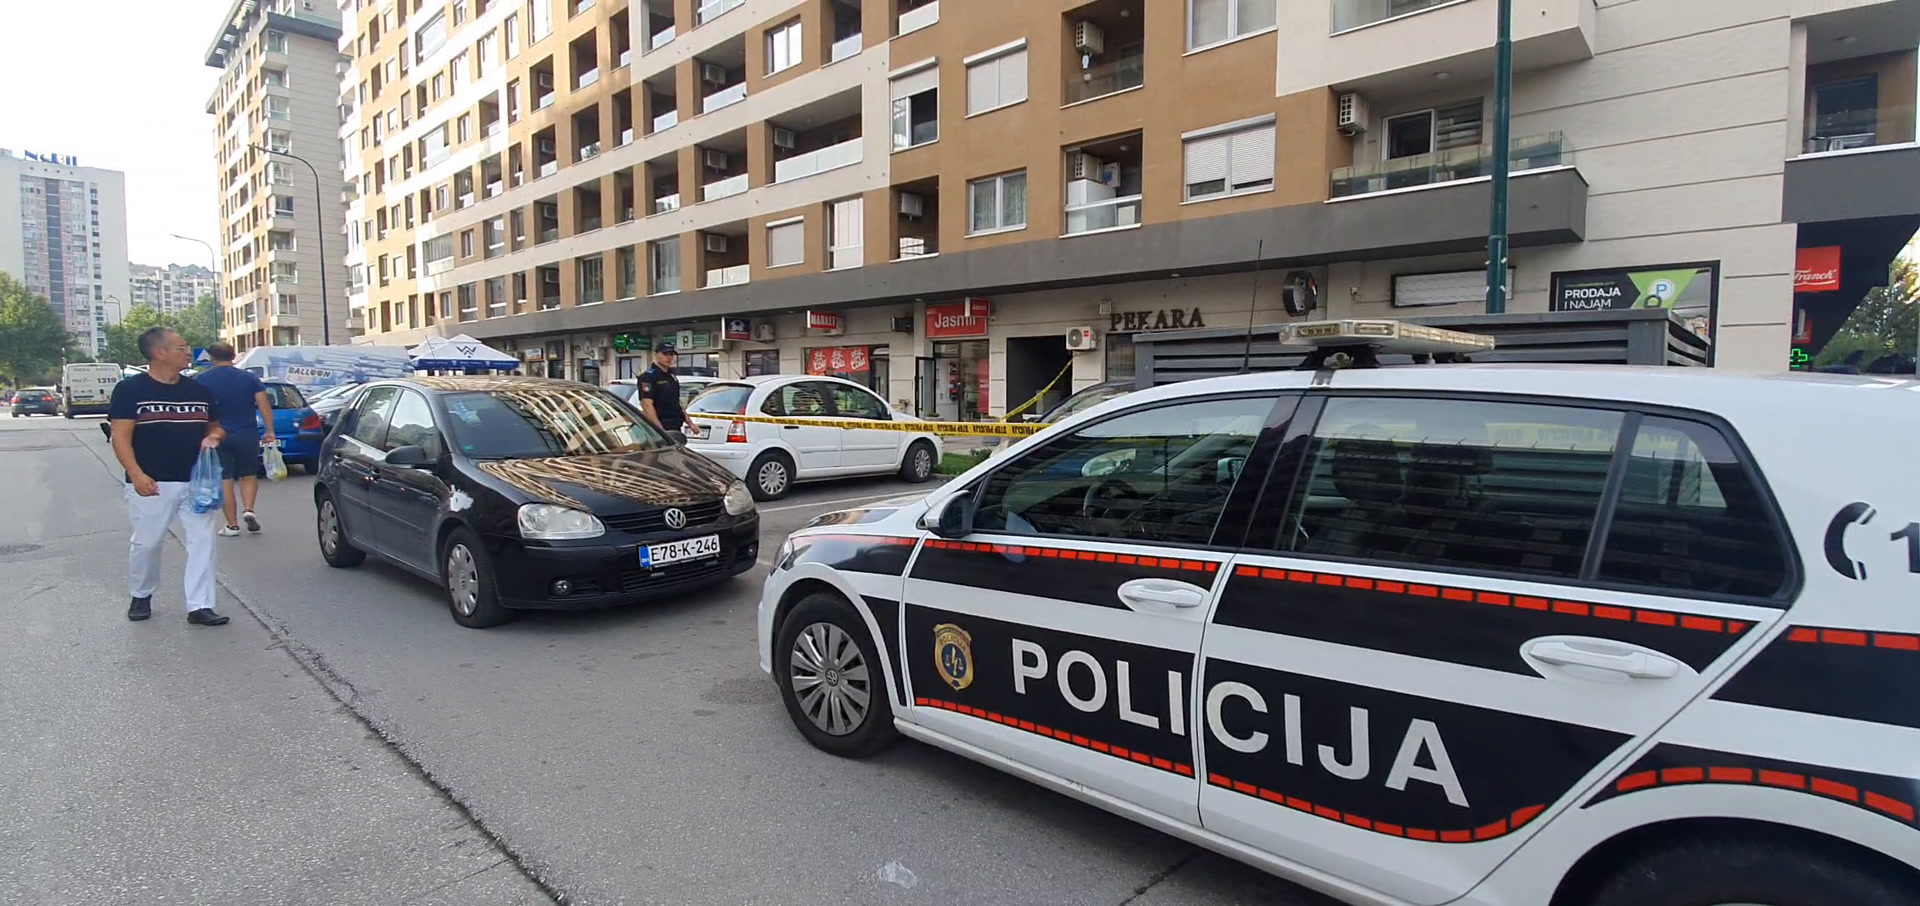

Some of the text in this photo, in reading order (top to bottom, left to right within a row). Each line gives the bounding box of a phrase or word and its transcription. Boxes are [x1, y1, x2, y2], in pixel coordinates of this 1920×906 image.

[1794, 268, 1837, 281] Franck
[1565, 287, 1621, 299] PRODAJA
[1569, 298, 1612, 309] NAJAM
[811, 314, 835, 326] MARKET
[1109, 307, 1205, 331] PEKARA
[288, 367, 331, 378] BALLOON
[651, 538, 717, 562] E78-K-246
[1012, 638, 1470, 808] POLICIJA
